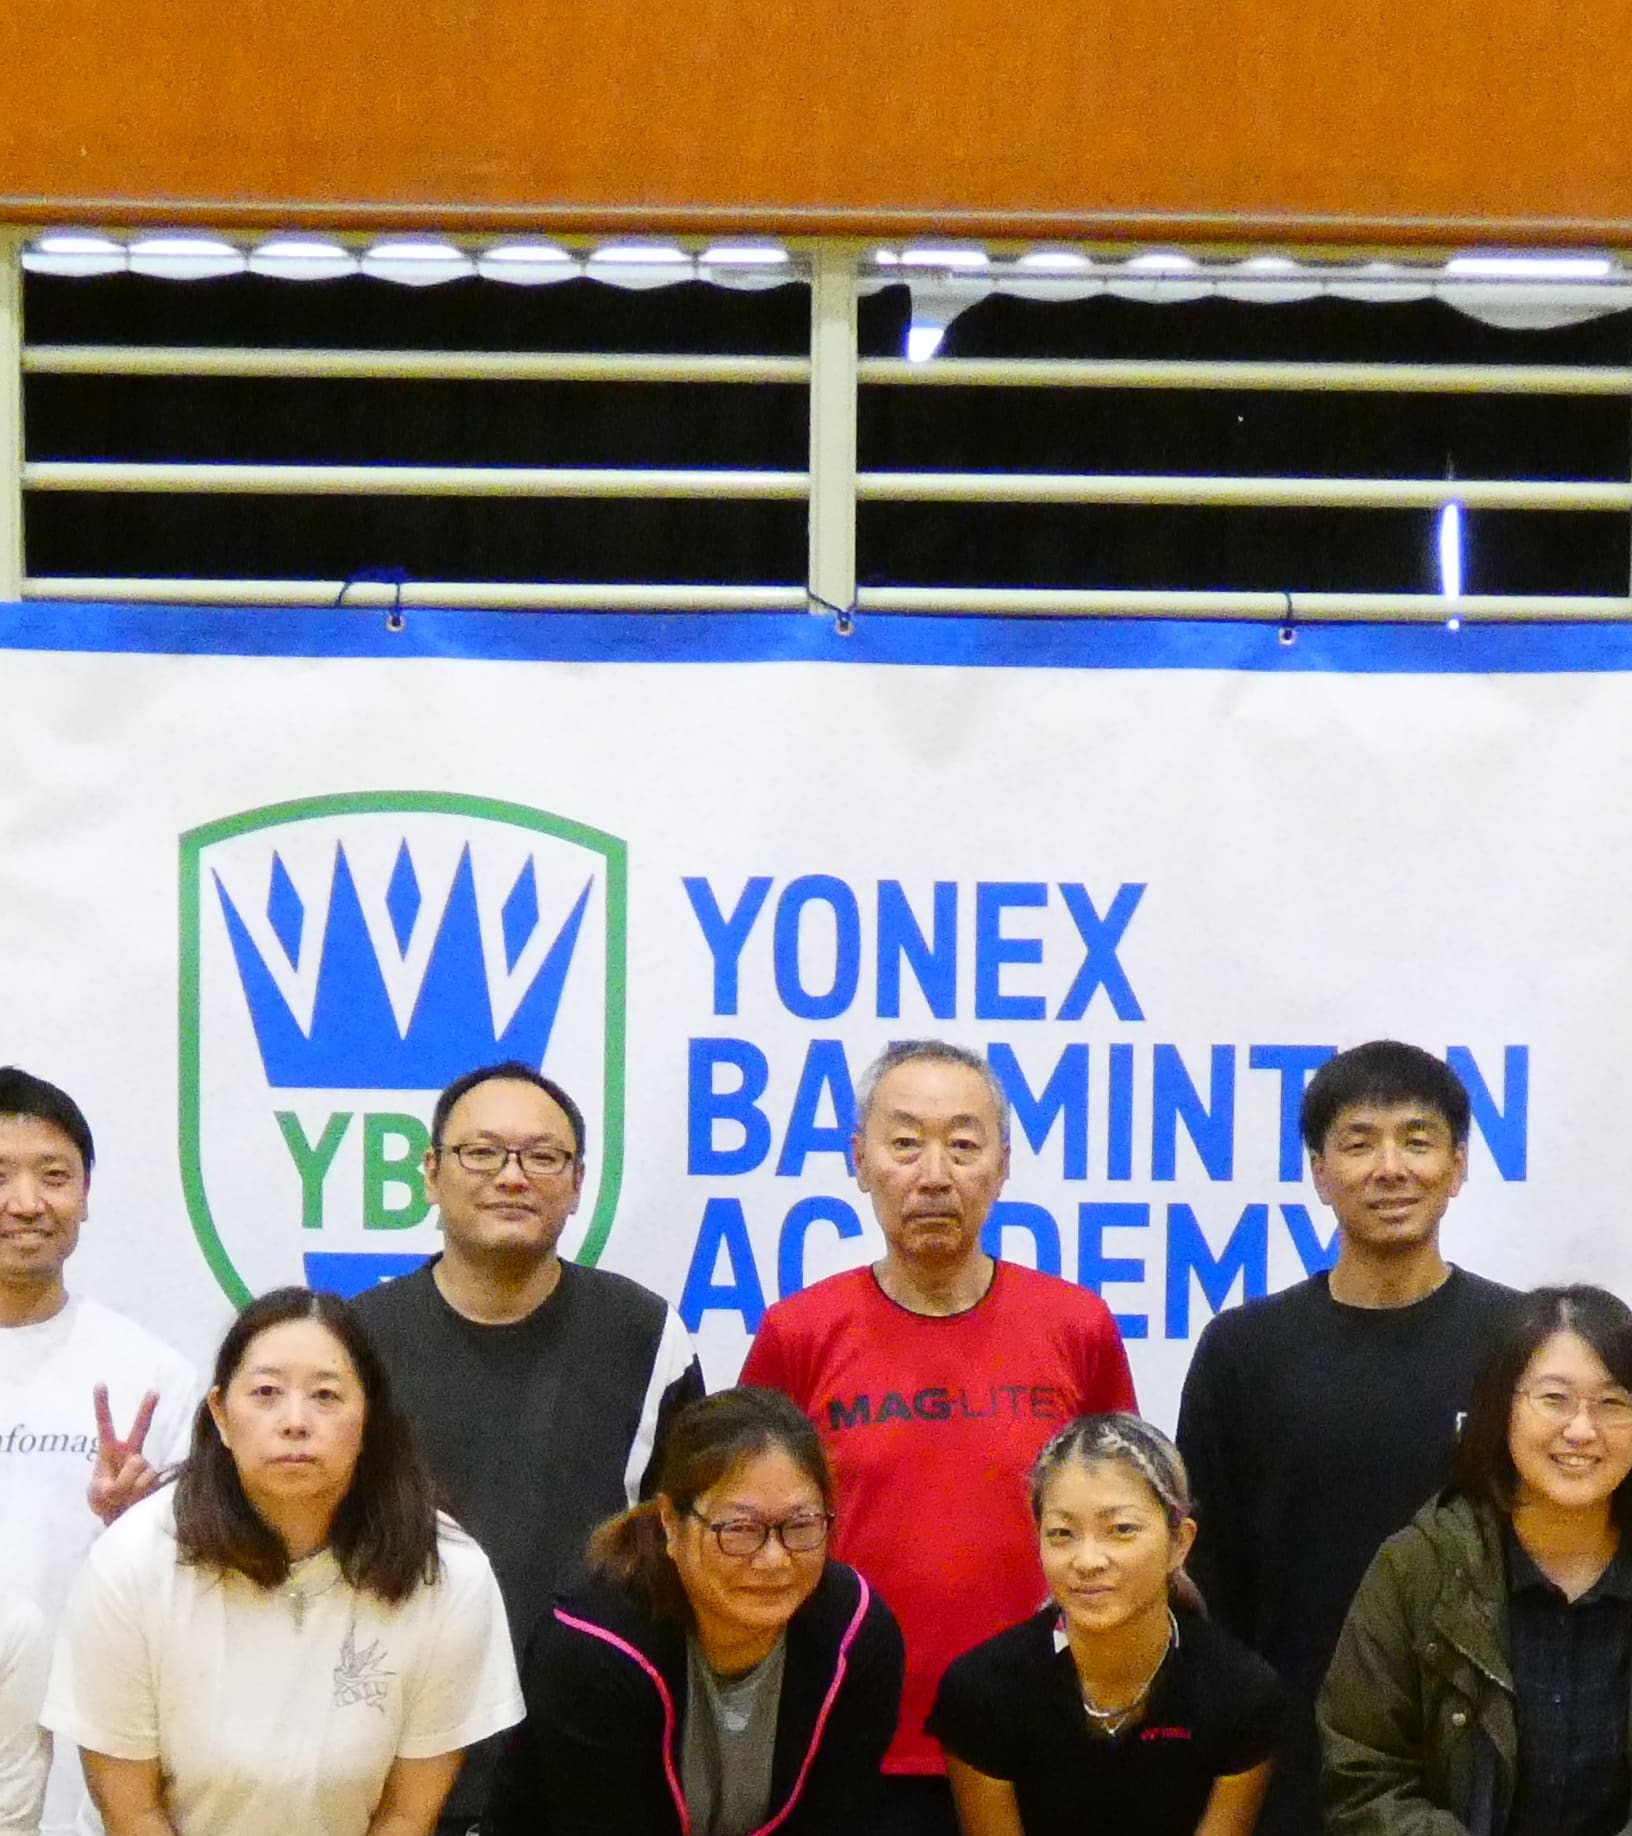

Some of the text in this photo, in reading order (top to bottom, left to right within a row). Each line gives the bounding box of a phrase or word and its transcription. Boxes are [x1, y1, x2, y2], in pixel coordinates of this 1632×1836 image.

[681, 874, 1148, 1021] YONEX
[273, 1110, 442, 1230] YB
[687, 1037, 1529, 1182] BAMINTN
